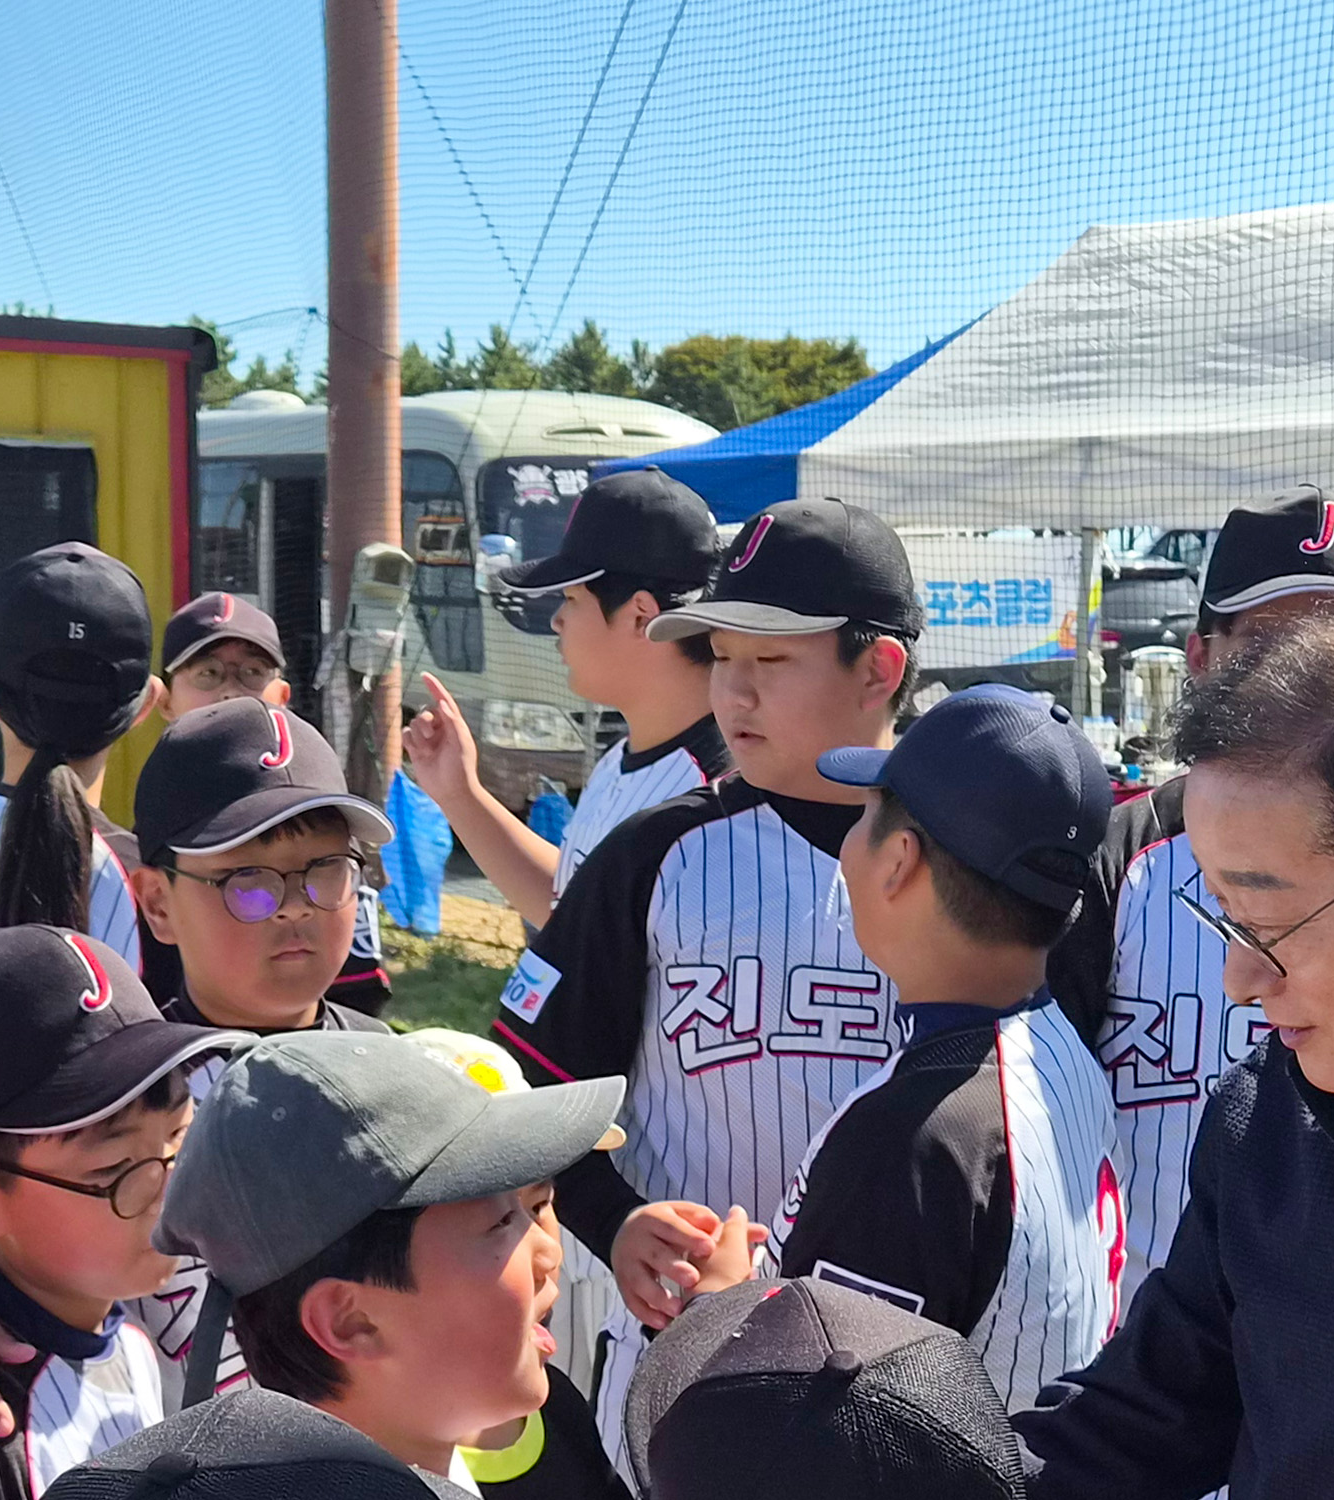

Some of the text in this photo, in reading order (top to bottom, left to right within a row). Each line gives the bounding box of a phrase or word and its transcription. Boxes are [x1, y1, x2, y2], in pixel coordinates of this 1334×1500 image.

[728, 513, 774, 573] J
[214, 594, 235, 624] J
[917, 578, 1052, 627] 포츠클럽
[68, 622, 85, 639] 15
[258, 709, 294, 770] J
[63, 933, 113, 1014] J
